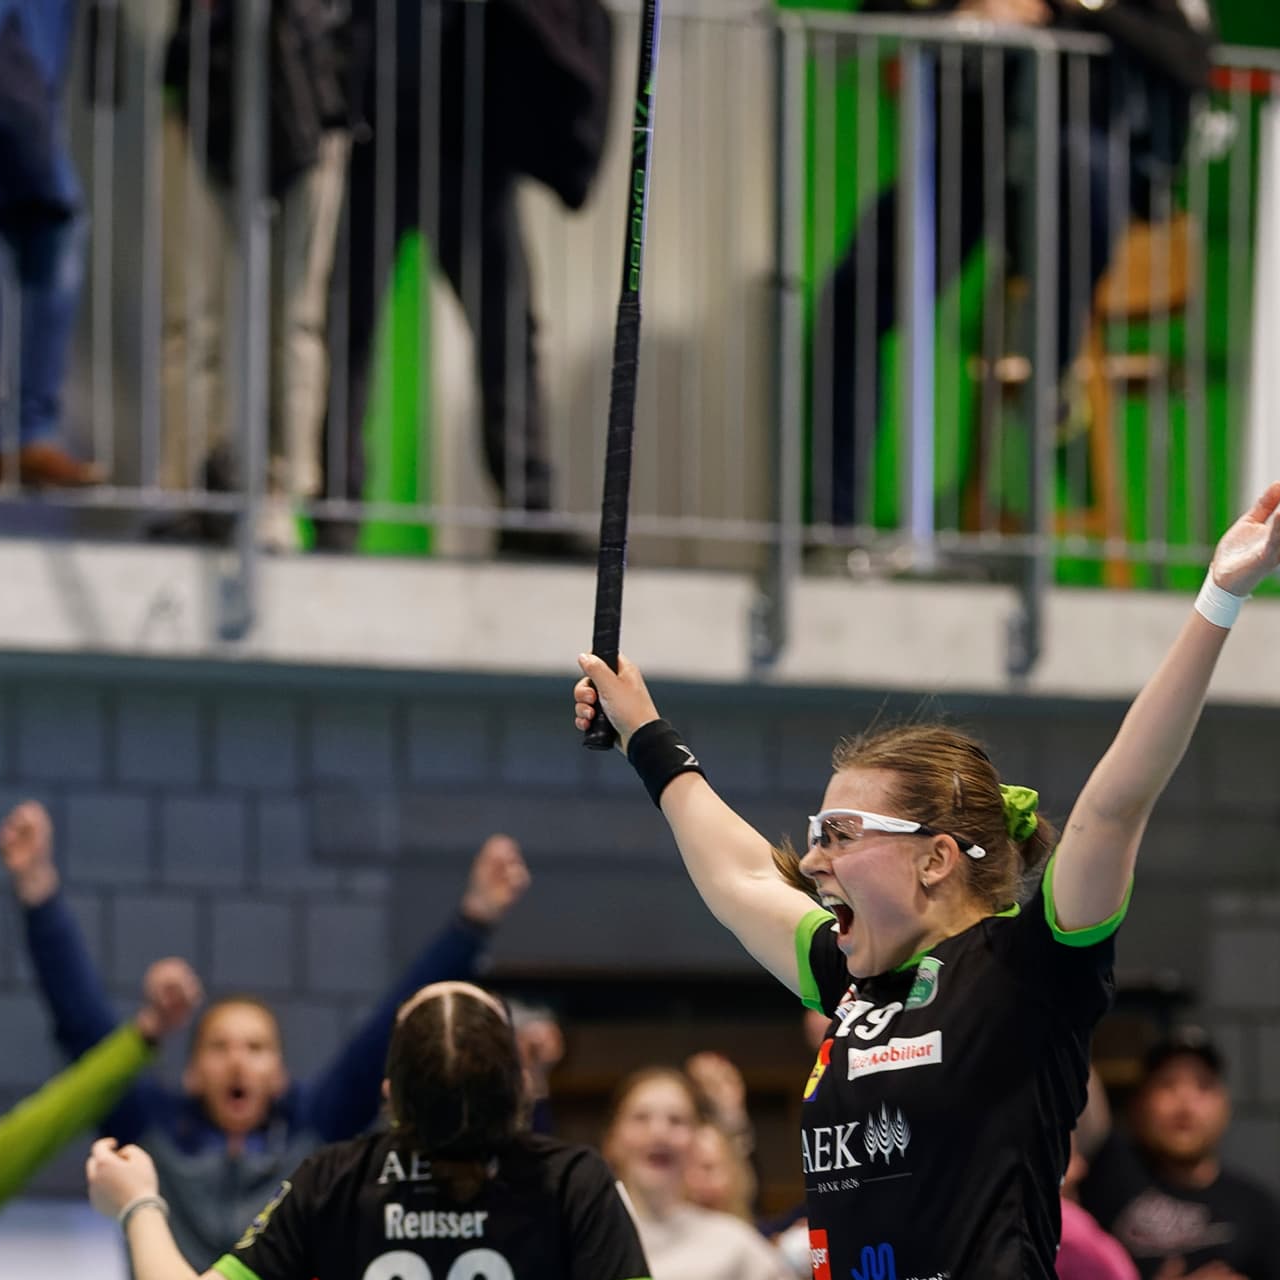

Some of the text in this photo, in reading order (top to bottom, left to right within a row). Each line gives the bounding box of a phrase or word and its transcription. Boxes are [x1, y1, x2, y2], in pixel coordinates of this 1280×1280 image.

[801, 1120, 862, 1174] AEK
[377, 1150, 433, 1184] AE
[384, 1202, 489, 1241] Reusser
